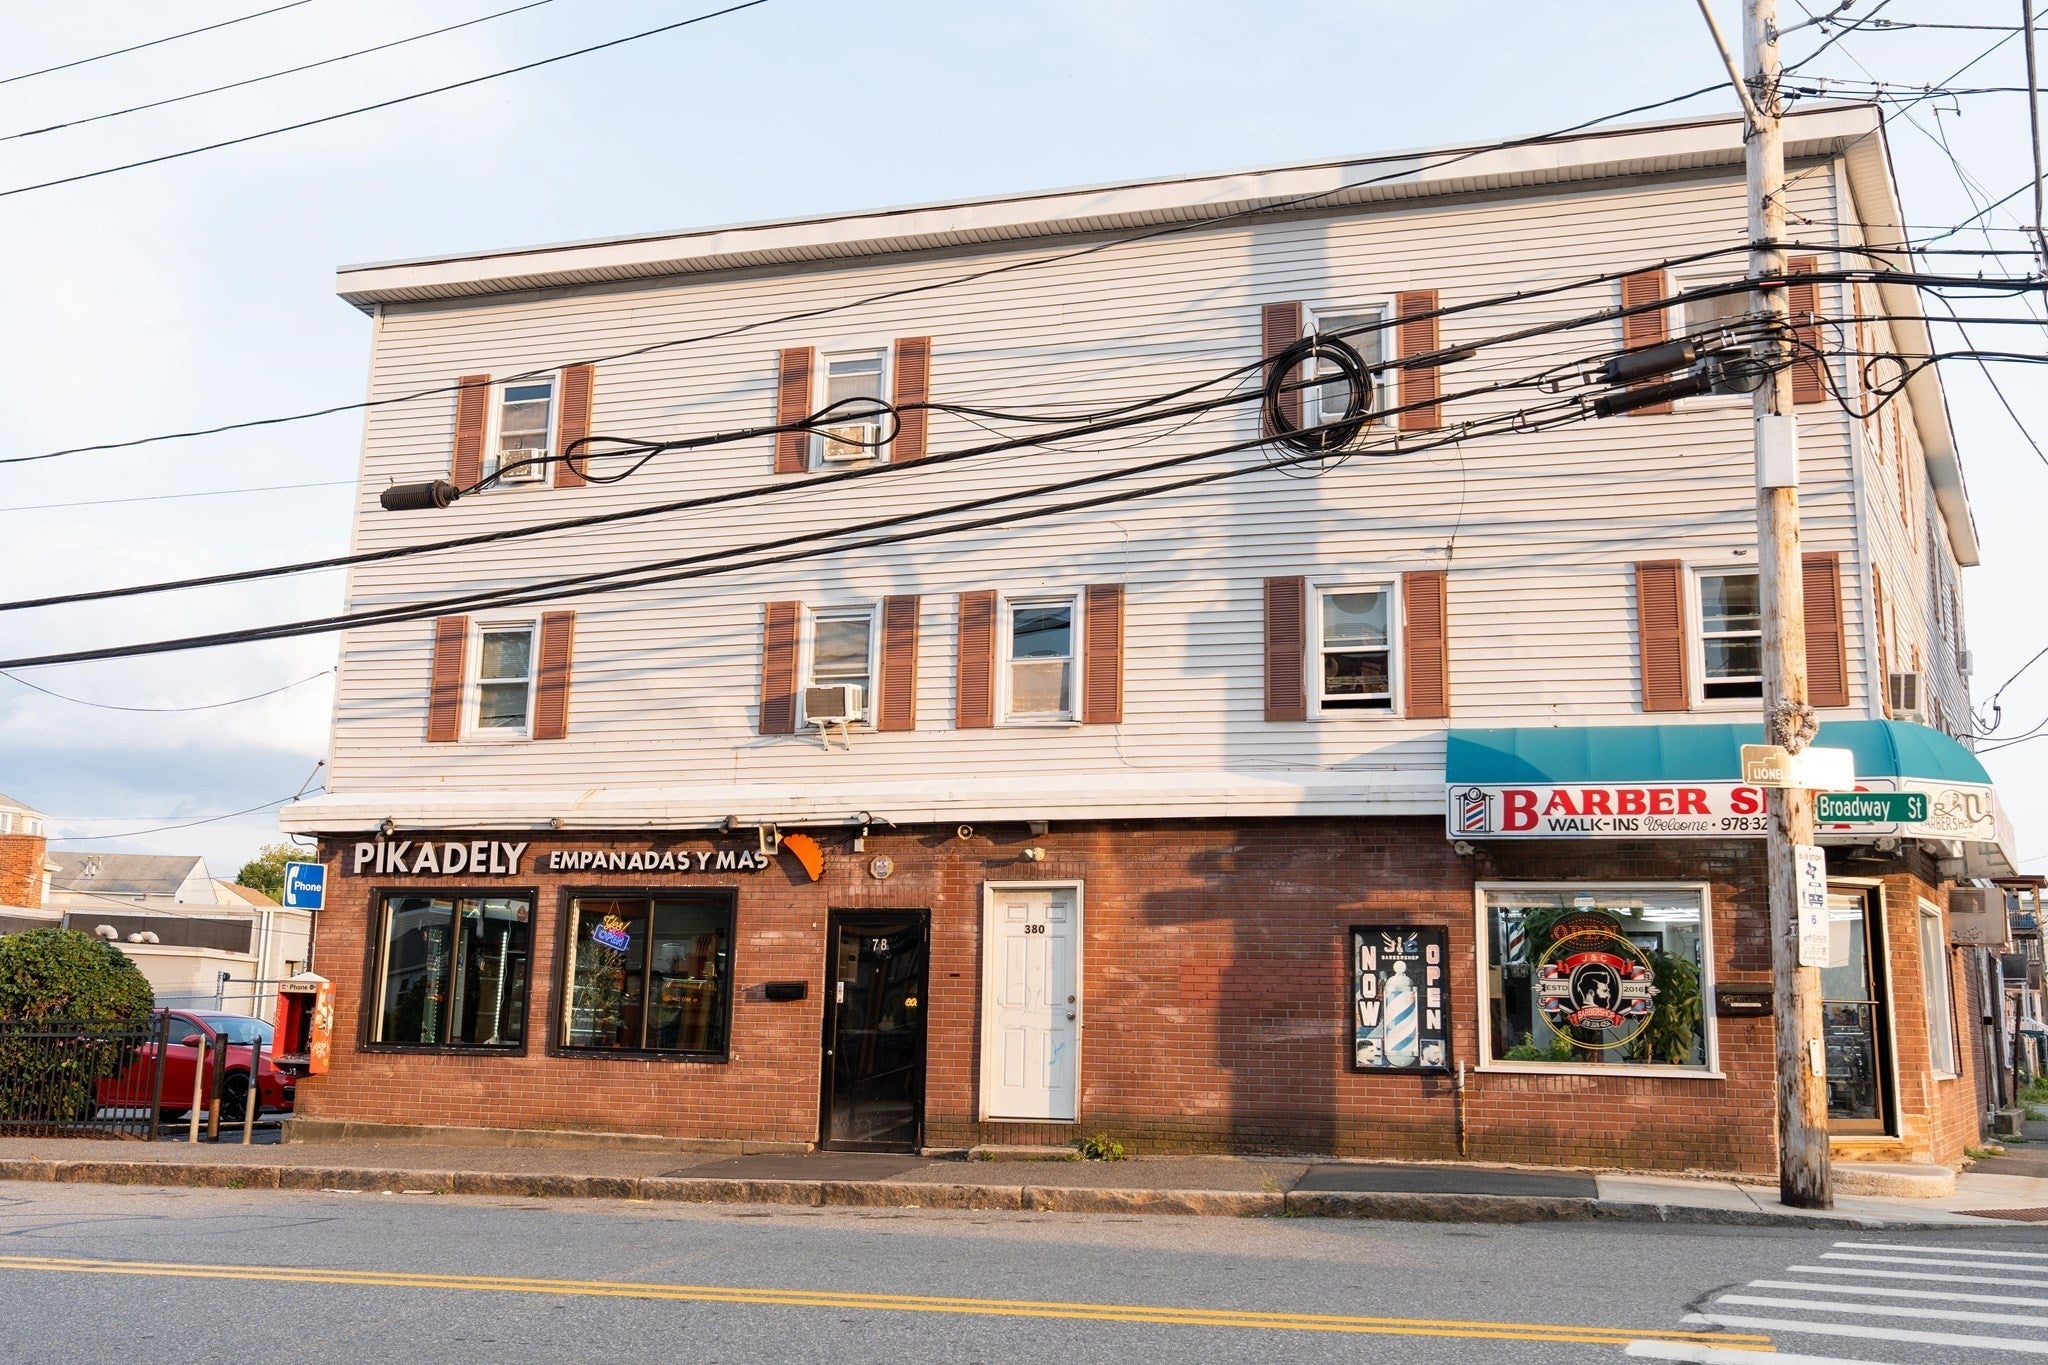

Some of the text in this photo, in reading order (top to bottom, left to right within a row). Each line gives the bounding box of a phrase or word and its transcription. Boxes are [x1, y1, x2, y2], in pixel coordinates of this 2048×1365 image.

[1753, 768, 1785, 780] LIONE
[1500, 788, 1712, 831] BARBER
[1820, 796, 1922, 822] Broadway St
[1547, 816, 1767, 832] WALK-INS Welcome 978-32
[353, 841, 528, 874] PIKADELY
[549, 850, 769, 870] EMPANADAS Y MAS
[294, 881, 322, 892] Phone
[1811, 914, 1817, 925] 6
[1024, 924, 1045, 934] 380
[1553, 925, 1618, 940] OPEN
[598, 929, 625, 947] OPEN
[872, 938, 888, 951] 78
[1359, 945, 1380, 1027] NOW
[1426, 944, 1441, 1030] OPEN
[1577, 1007, 1615, 1020] BARBERSHOP
